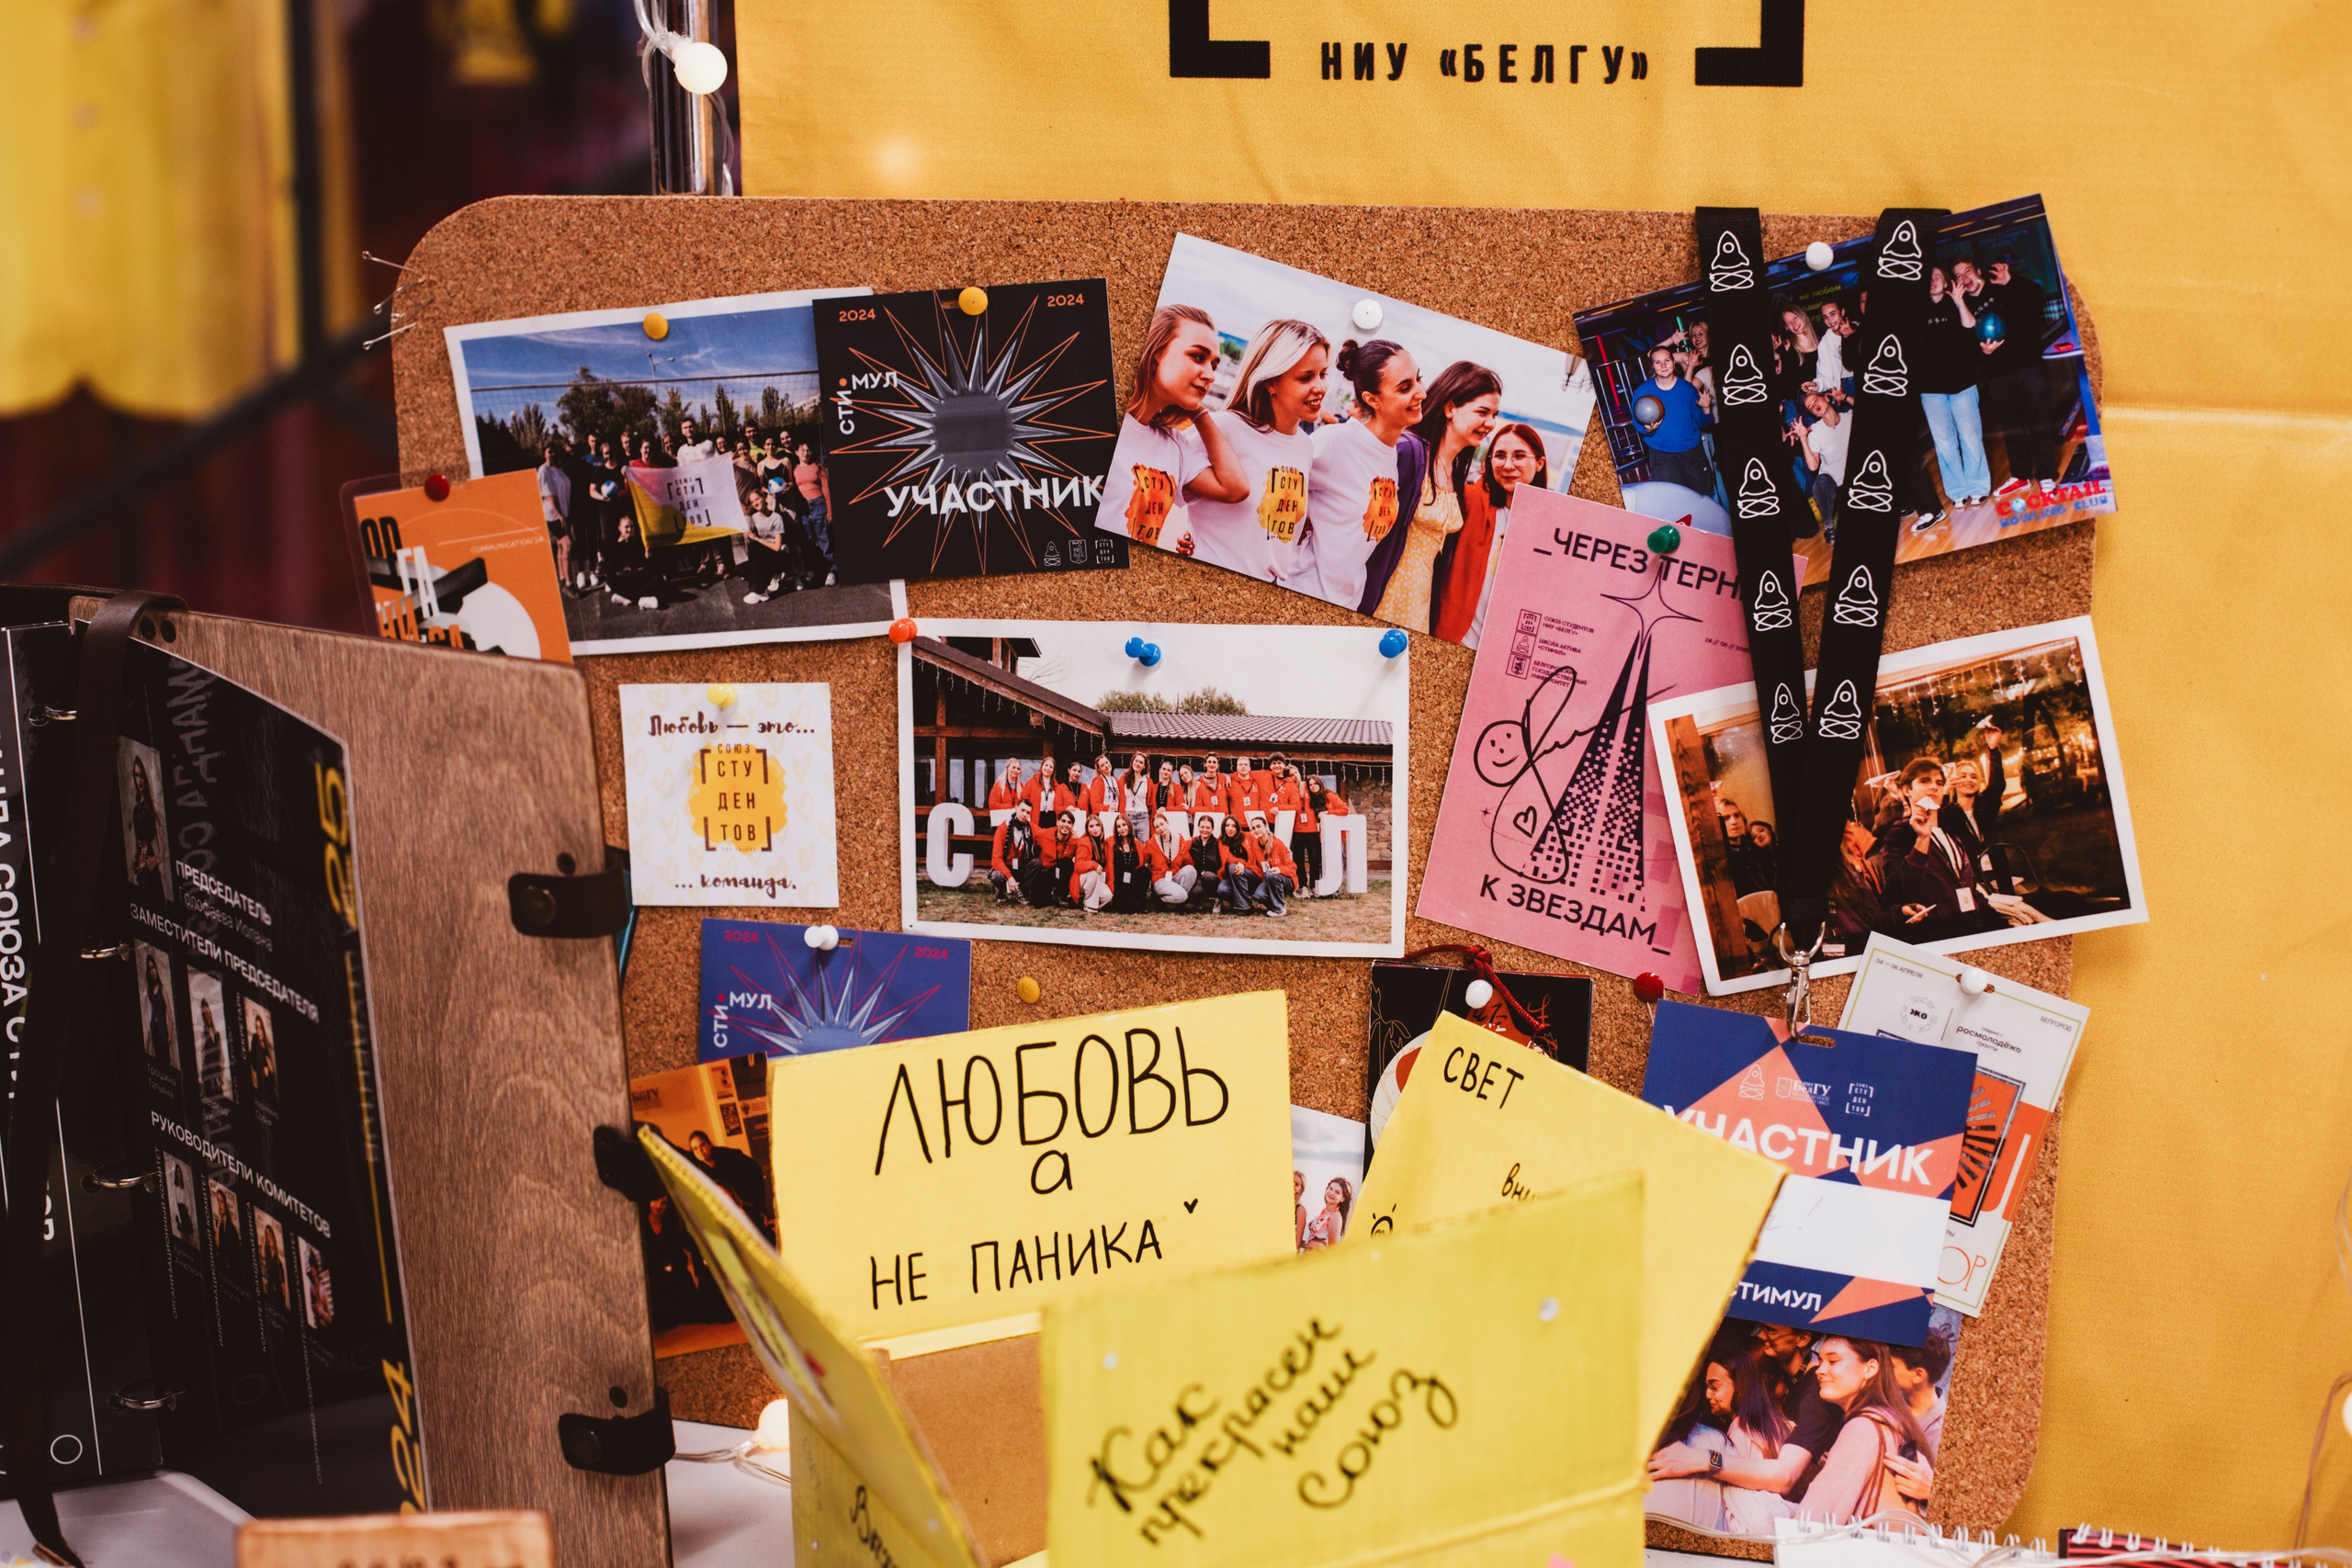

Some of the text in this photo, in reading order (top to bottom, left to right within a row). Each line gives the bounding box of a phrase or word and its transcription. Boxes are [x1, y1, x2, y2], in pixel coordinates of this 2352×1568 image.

[1321, 41, 1648, 85] НИУ «БЕЛГУ»
[838, 309, 876, 322] 2024
[1047, 293, 1085, 308] 2024
[884, 474, 1105, 518] УЧАСТНИК
[2074, 495, 2109, 511] CLUB
[1659, 554, 1743, 601] ТЕРН
[648, 711, 718, 737] Любовь
[718, 743, 751, 754] СОЮЗ
[718, 761, 752, 777] СТУ
[718, 792, 755, 811] ДЕН
[720, 824, 756, 841] ТОВ
[175, 860, 272, 926] ПРЕДСЕДАТЕЛЬ
[1479, 874, 1500, 902] К
[724, 930, 759, 943] 2024
[914, 946, 949, 960] 2024
[130, 902, 320, 1024] ЗАМЕСТИТЕЛИ ПРЕДСЕДАТЕЛЯ
[2040, 1015, 2073, 1032] БЕЛГОРОД
[1442, 1045, 1525, 1111] СВЕТ
[874, 1025, 1231, 1176] ЛЮБОВЬ
[151, 1111, 254, 1184] РУКОВОДИТЕЛИ
[255, 1172, 331, 1239] КОМИТЕТОВ
[154, 1146, 179, 1319] ОРГАНИЗАЦИОННЫЙ КОМИТЕТ
[200, 1172, 225, 1348] ИНФОРМАЦИОННЫЙ КОМИТЕТ
[245, 1201, 267, 1353] КОМИТЕТ ФАНДРАЙЗИНГА
[869, 1218, 1163, 1310] НЕ ПАНИКА
[1085, 1382, 1223, 1514] Как
